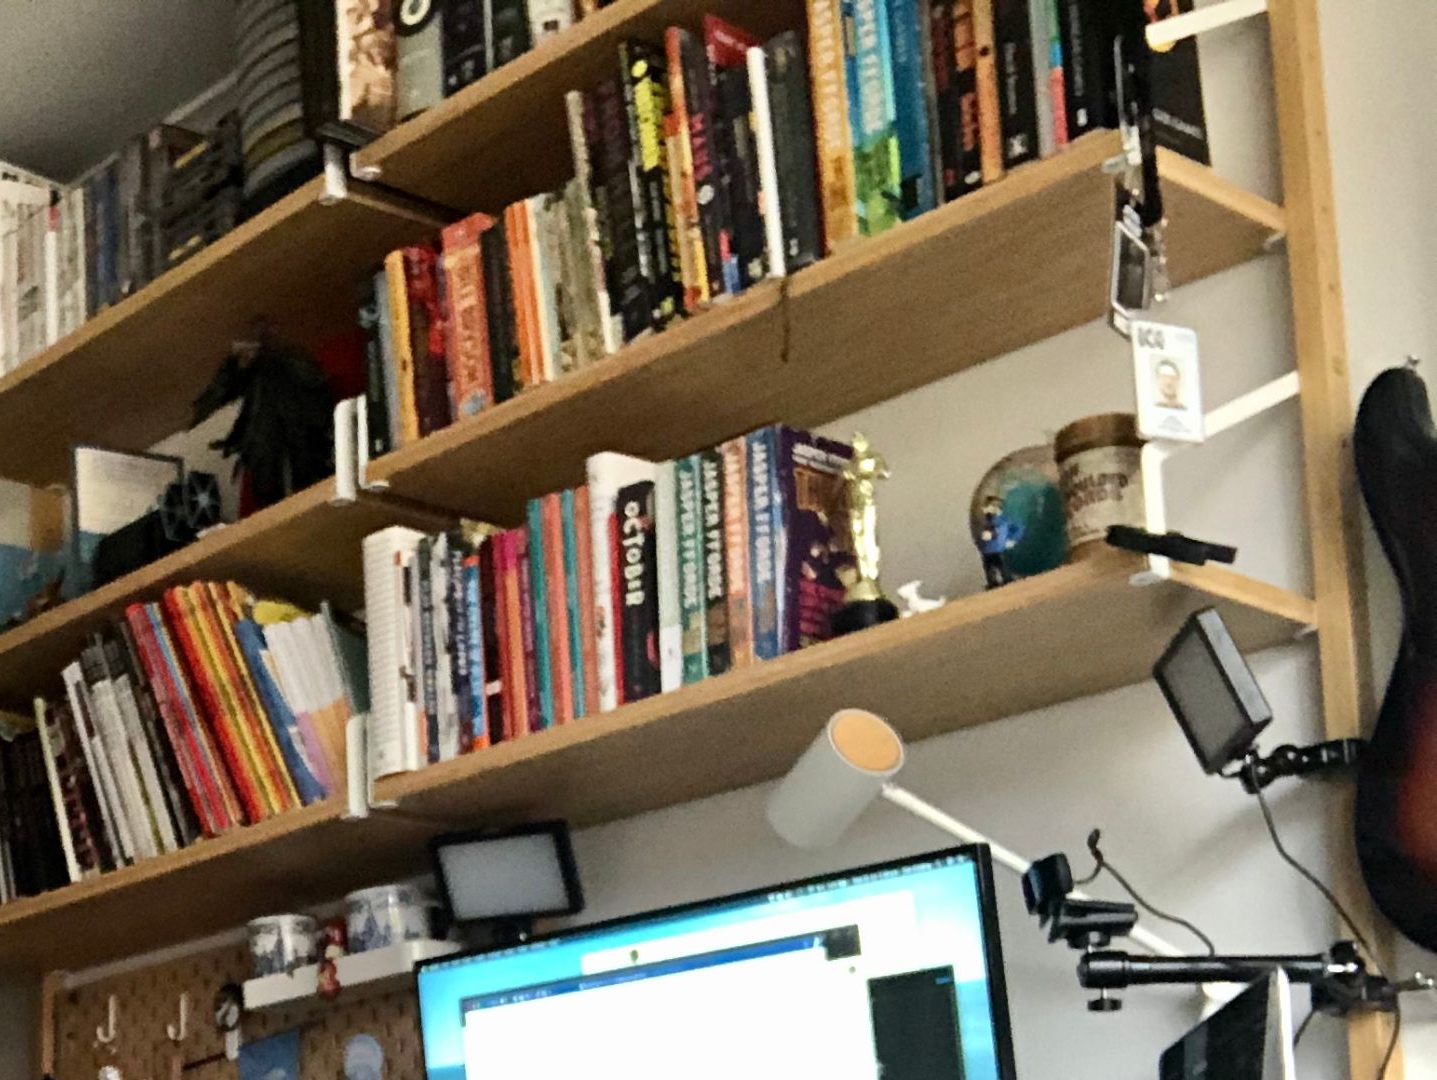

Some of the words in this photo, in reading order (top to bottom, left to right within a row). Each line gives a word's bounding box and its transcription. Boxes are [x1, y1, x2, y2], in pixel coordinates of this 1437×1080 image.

[679, 470, 695, 536] JASPER
[704, 459, 721, 528] JASPER
[752, 440, 770, 510] JASPER
[623, 501, 645, 606] OCTOBER
